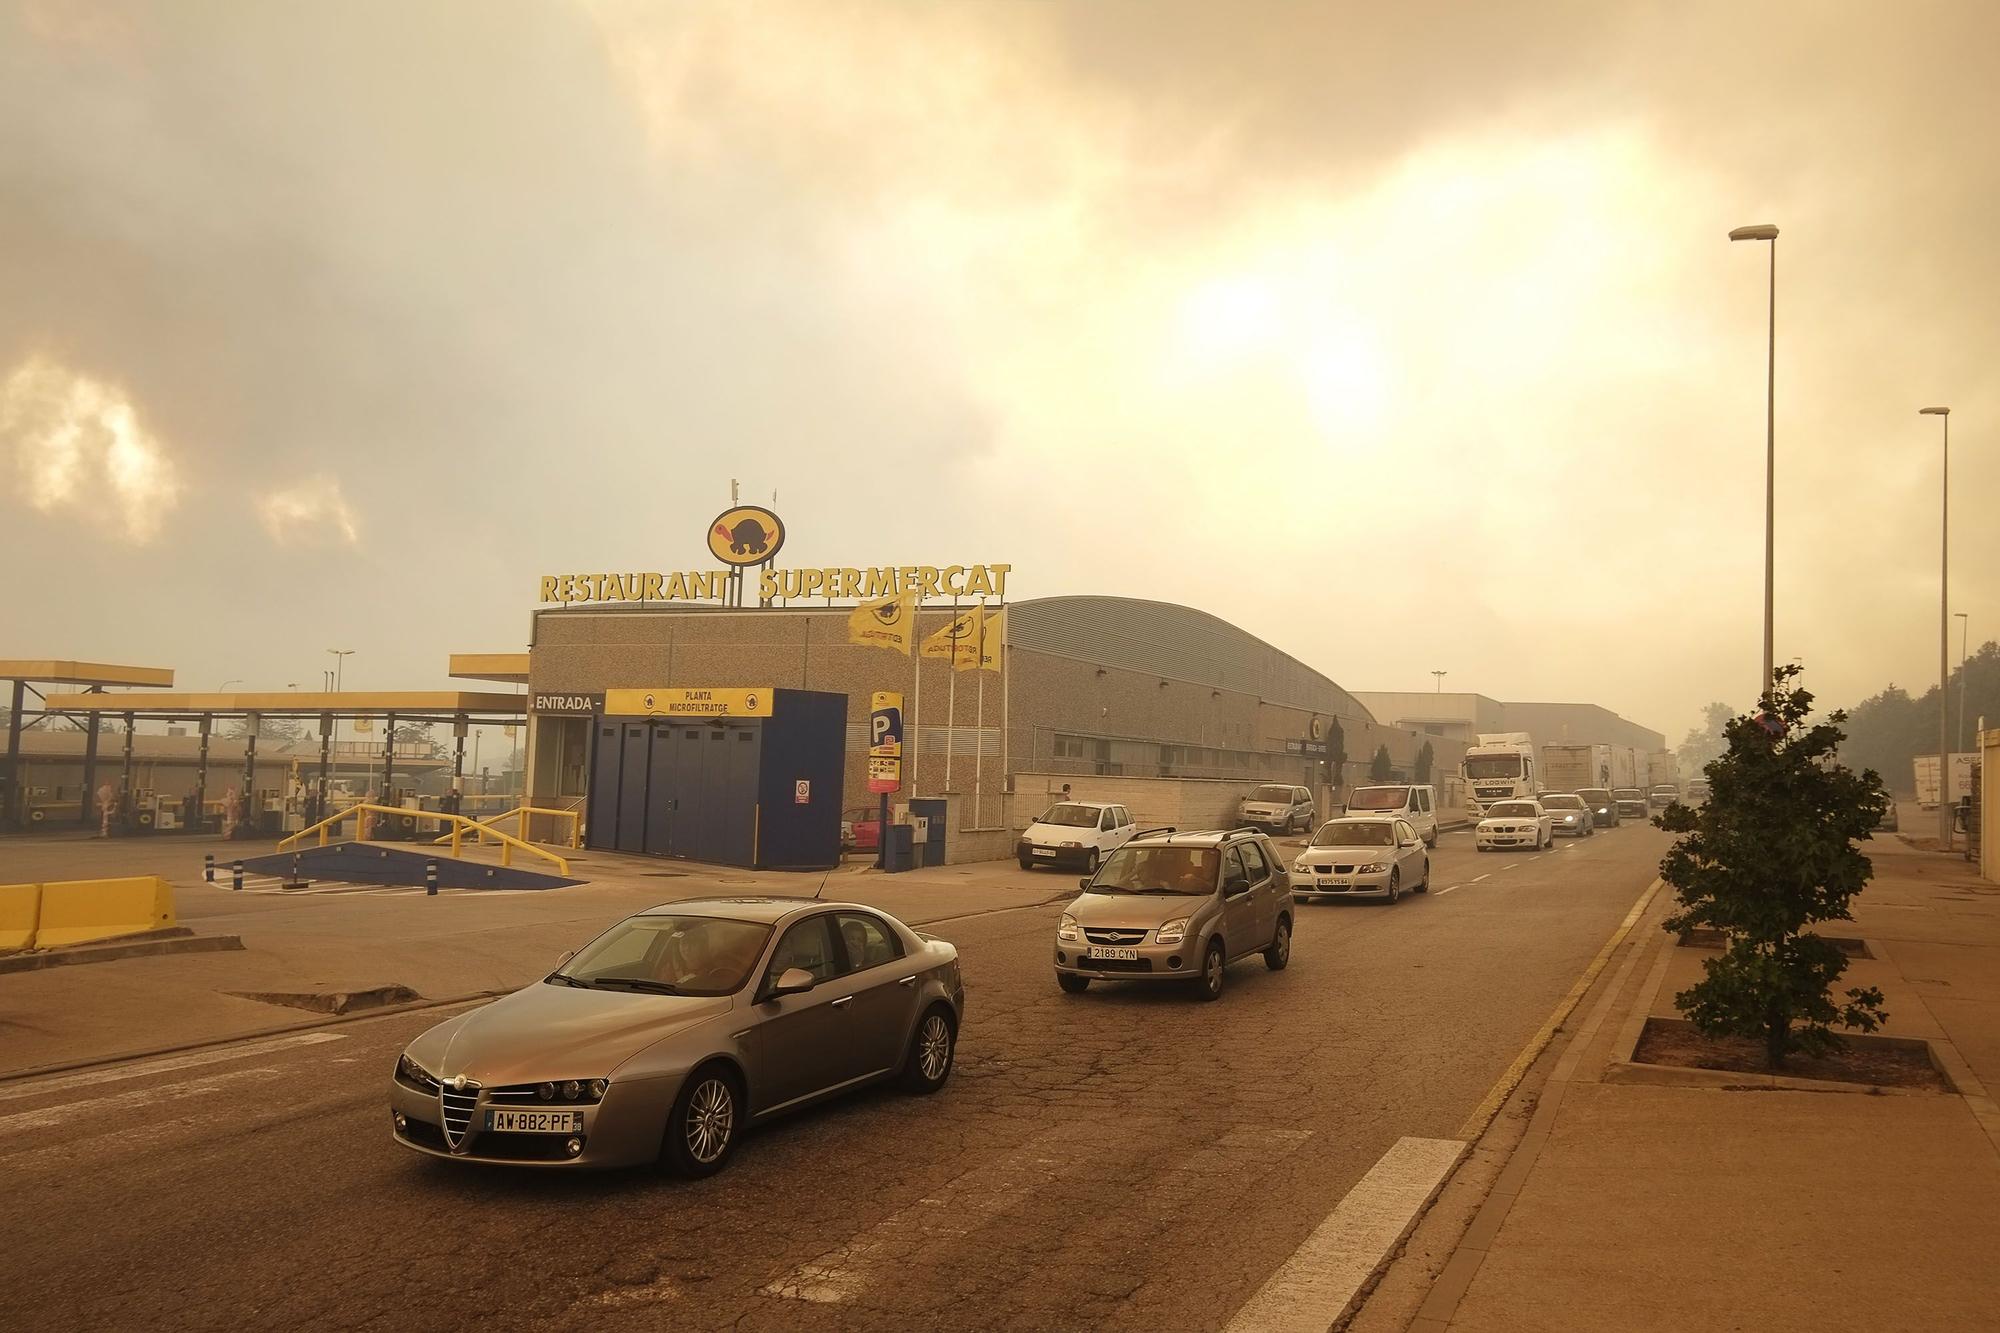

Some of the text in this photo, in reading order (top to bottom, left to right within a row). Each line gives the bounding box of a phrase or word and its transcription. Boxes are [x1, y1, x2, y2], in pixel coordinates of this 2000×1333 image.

[540, 564, 1011, 602] RESTAURANT SUPERMERCAT
[685, 691, 712, 700] PLANTA
[536, 695, 592, 710] ENTRADA
[669, 703, 728, 712] MICROFILTRATGE
[873, 715, 890, 743] P
[1094, 948, 1136, 959] 2189 CYN
